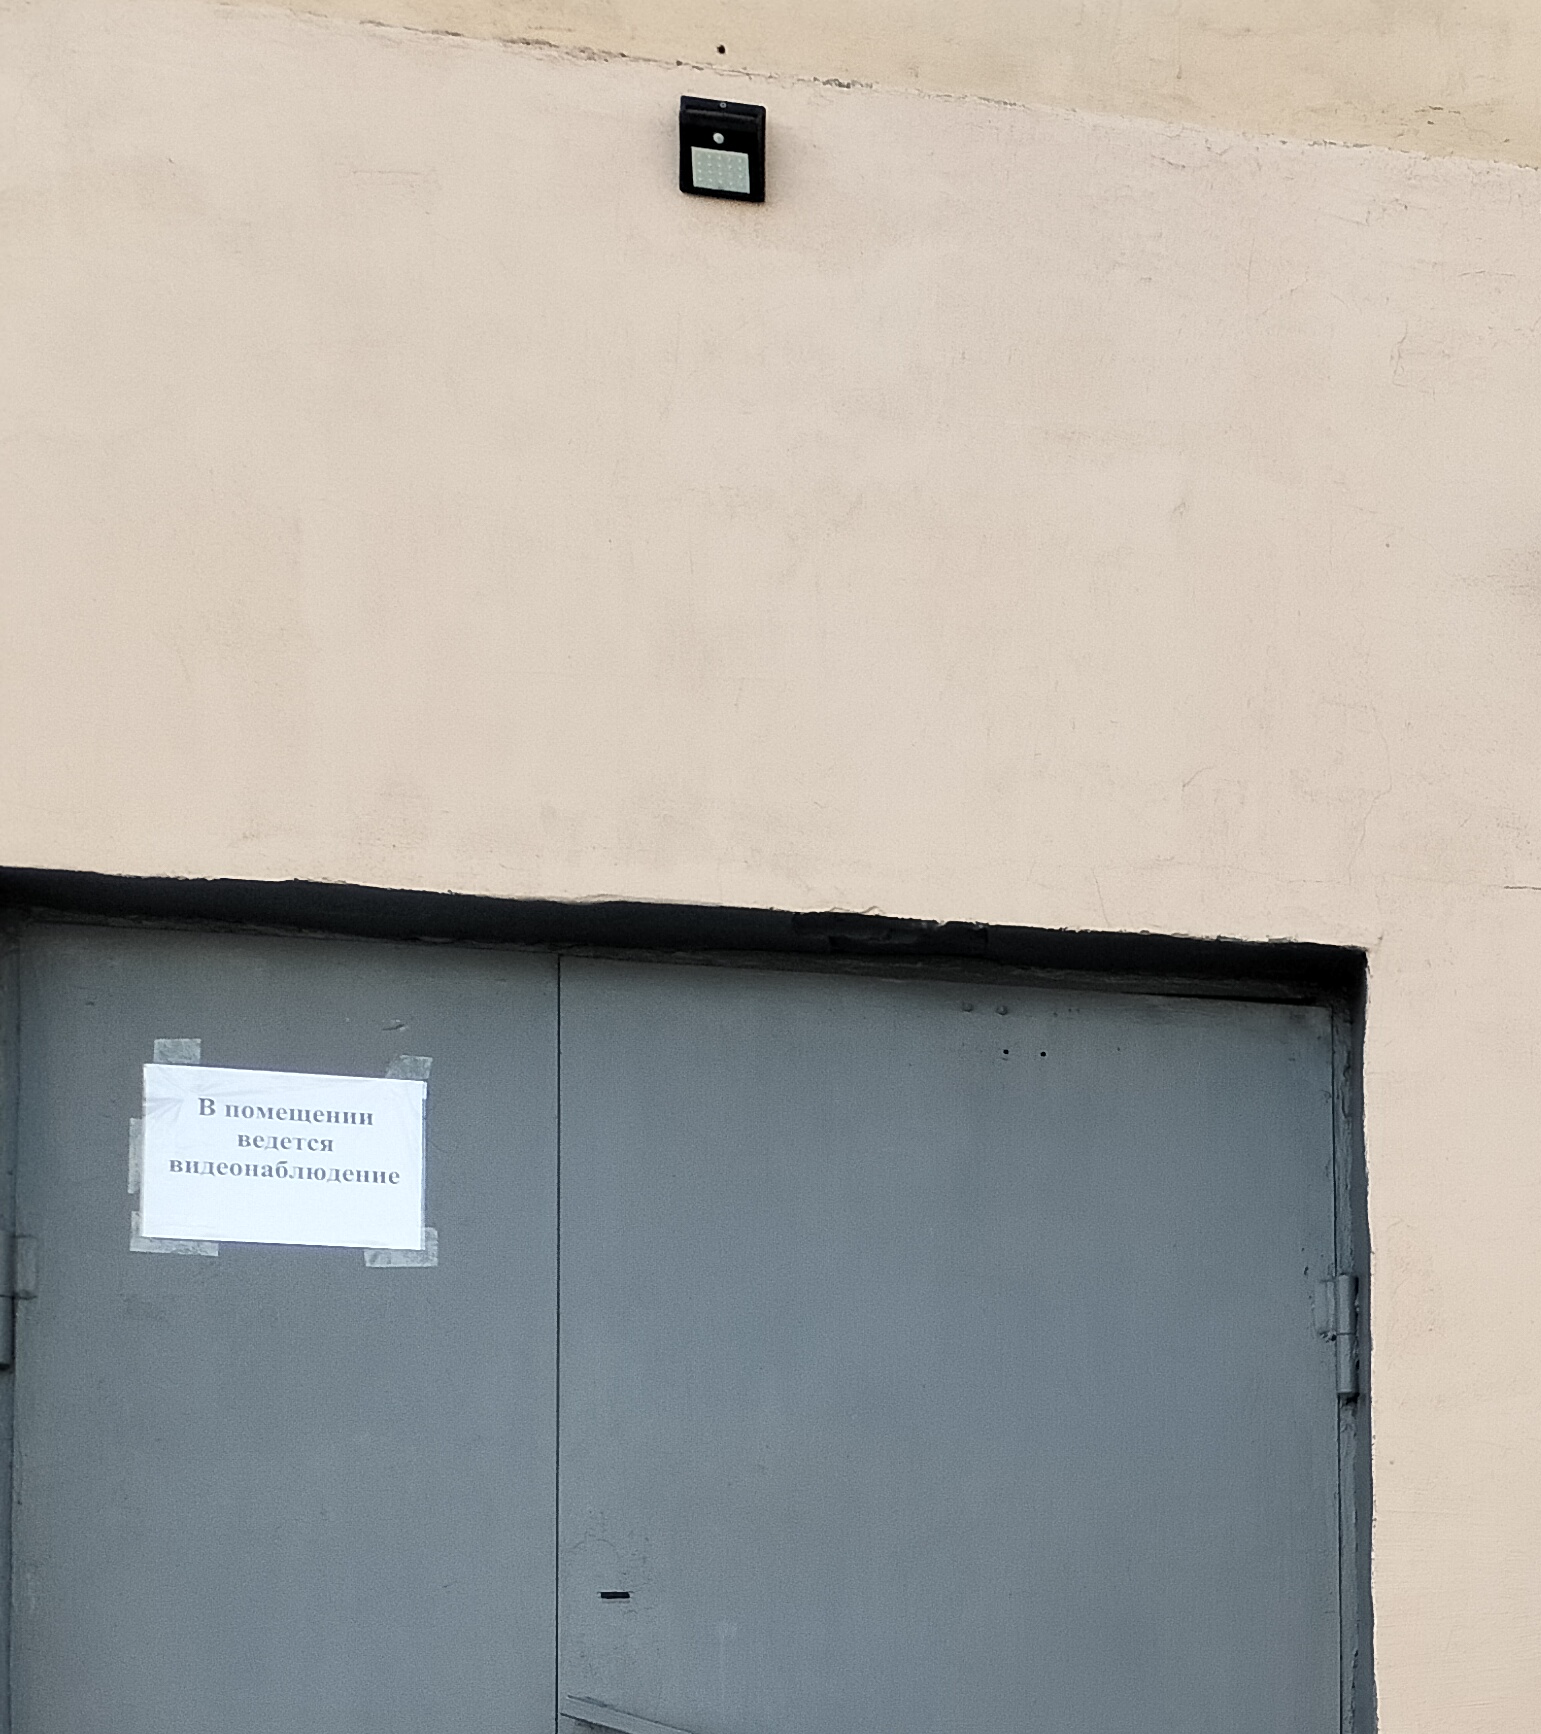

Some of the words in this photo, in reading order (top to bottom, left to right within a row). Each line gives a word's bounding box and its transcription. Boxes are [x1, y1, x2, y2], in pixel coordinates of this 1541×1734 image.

[198, 1097, 216, 1116] В
[225, 1104, 373, 1125] помещении
[237, 1133, 333, 1152] ведется
[169, 1158, 401, 1185] видеонаблюдение
